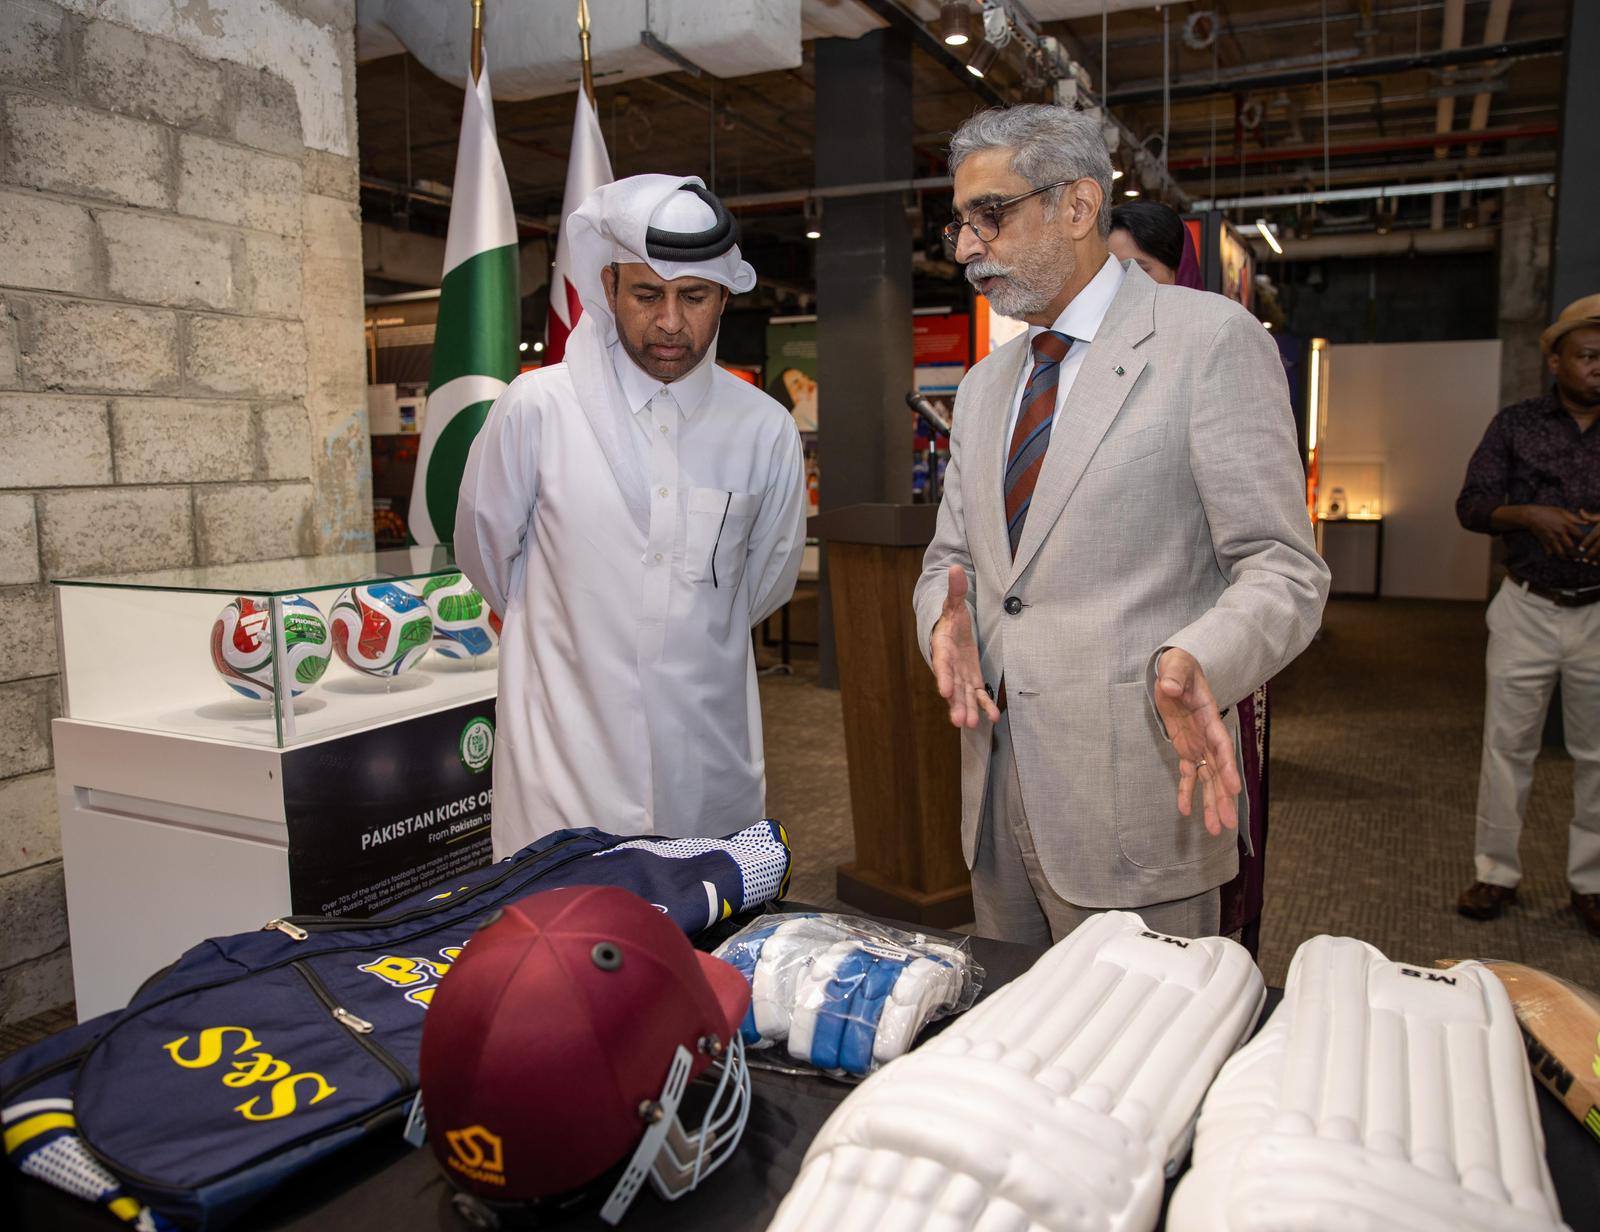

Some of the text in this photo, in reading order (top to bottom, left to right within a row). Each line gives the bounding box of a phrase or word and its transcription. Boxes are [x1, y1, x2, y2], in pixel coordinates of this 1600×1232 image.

[361, 811, 433, 850] PAKISTAN
[437, 795, 475, 822] KICKS
[428, 812, 491, 843] From Pakistan to
[321, 899, 336, 912] Over
[337, 893, 350, 905] 70%
[351, 890, 357, 900] of
[358, 885, 369, 896] the
[370, 876, 391, 892] world's
[391, 866, 415, 883] footballs
[416, 862, 425, 873] are
[426, 855, 442, 869] made
[448, 844, 471, 859] Pakistan
[332, 906, 341, 917] for
[342, 897, 363, 913] Russia
[378, 887, 388, 898] the
[410, 874, 418, 884] for
[419, 867, 435, 881] Qatar
[436, 861, 448, 874] 2022
[449, 856, 460, 868] and
[471, 848, 480, 859] the
[368, 894, 392, 912] Pakistan
[393, 882, 420, 901] continues
[421, 880, 427, 889] to
[428, 873, 444, 887] power
[445, 868, 454, 879] the
[455, 857, 478, 874] beautiful
[1140, 931, 1189, 949] MS
[1400, 968, 1457, 986] MS
[162, 1026, 337, 1121] S&S
